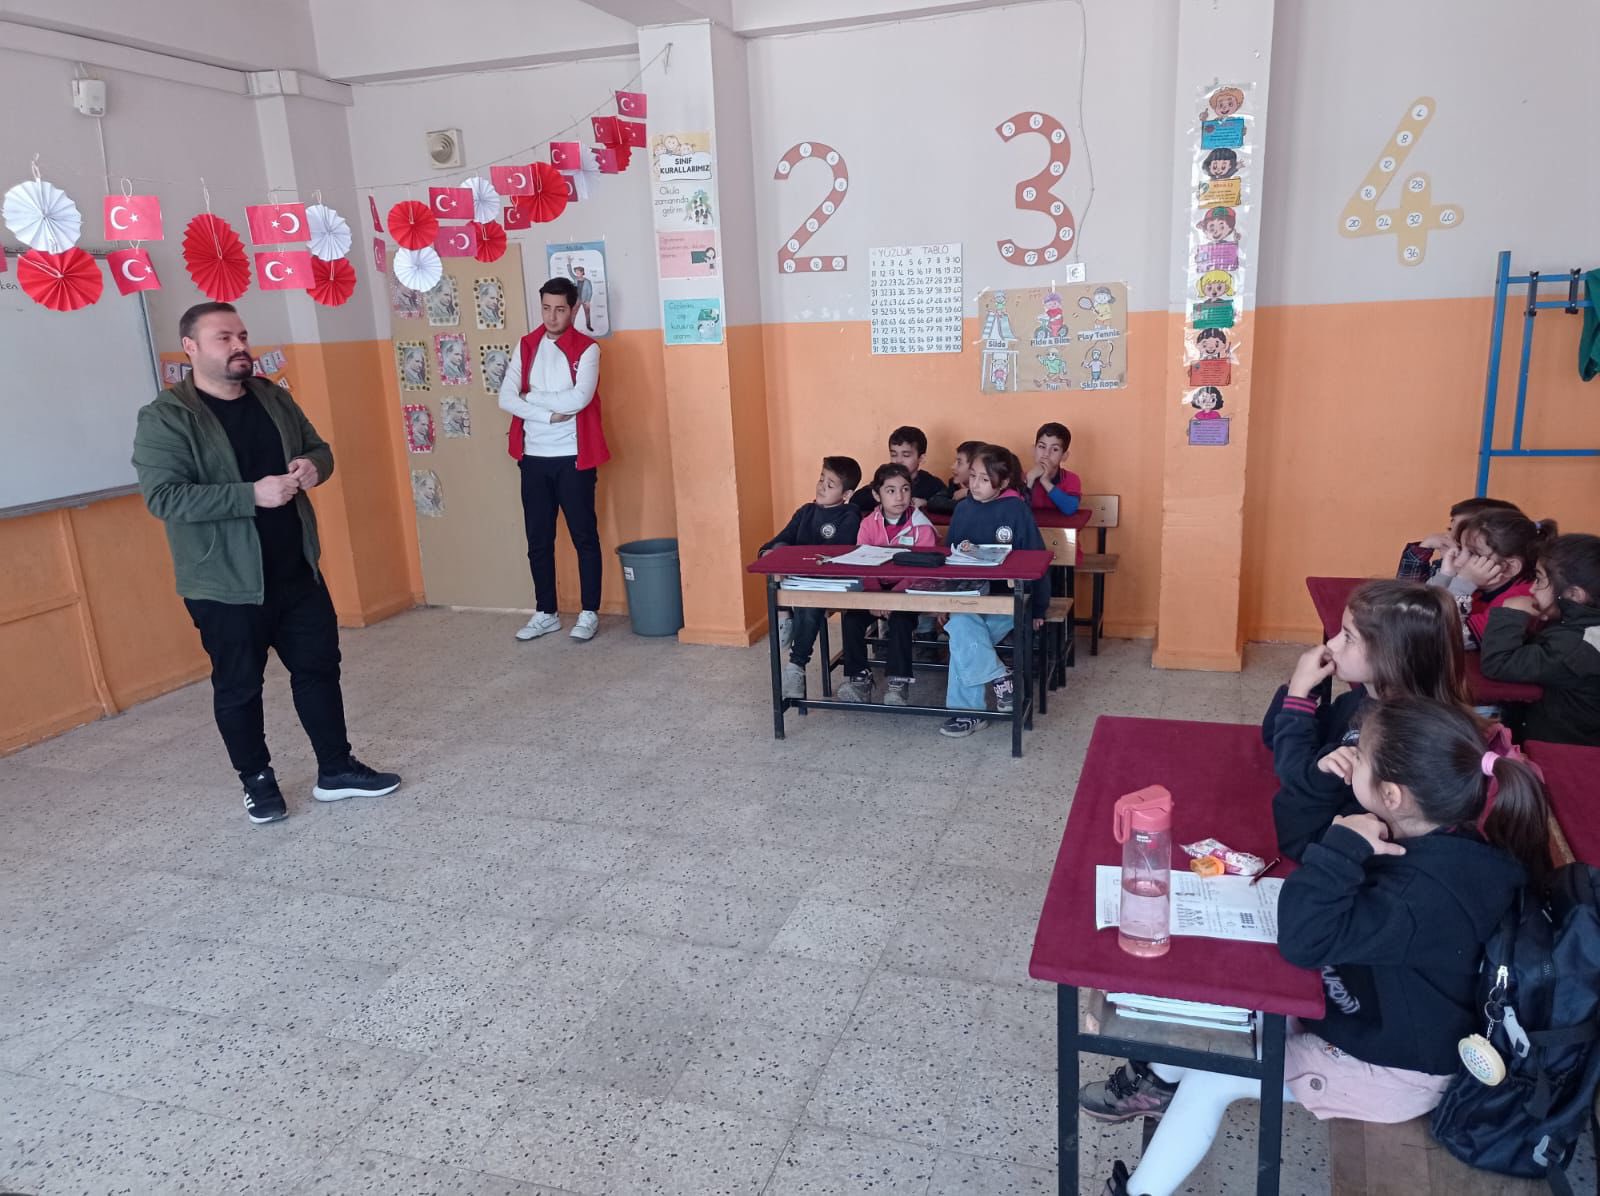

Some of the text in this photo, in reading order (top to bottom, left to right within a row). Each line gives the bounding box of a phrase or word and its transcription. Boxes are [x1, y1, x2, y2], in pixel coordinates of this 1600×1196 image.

[1401, 134, 1408, 143] 8
[675, 157, 692, 165] SINIF
[660, 164, 710, 174] KURALLARIMIZ
[1338, 96, 1464, 266] 4
[1411, 180, 1423, 189] 28
[995, 111, 1075, 267] 3
[774, 142, 849, 274] 2
[1348, 219, 1360, 228] 20
[1409, 214, 1420, 225] 32
[920, 245, 949, 254] TABLO
[1406, 248, 1419, 258] 36
[1094, 329, 1120, 338] Tennis
[1100, 381, 1119, 389] Rope
